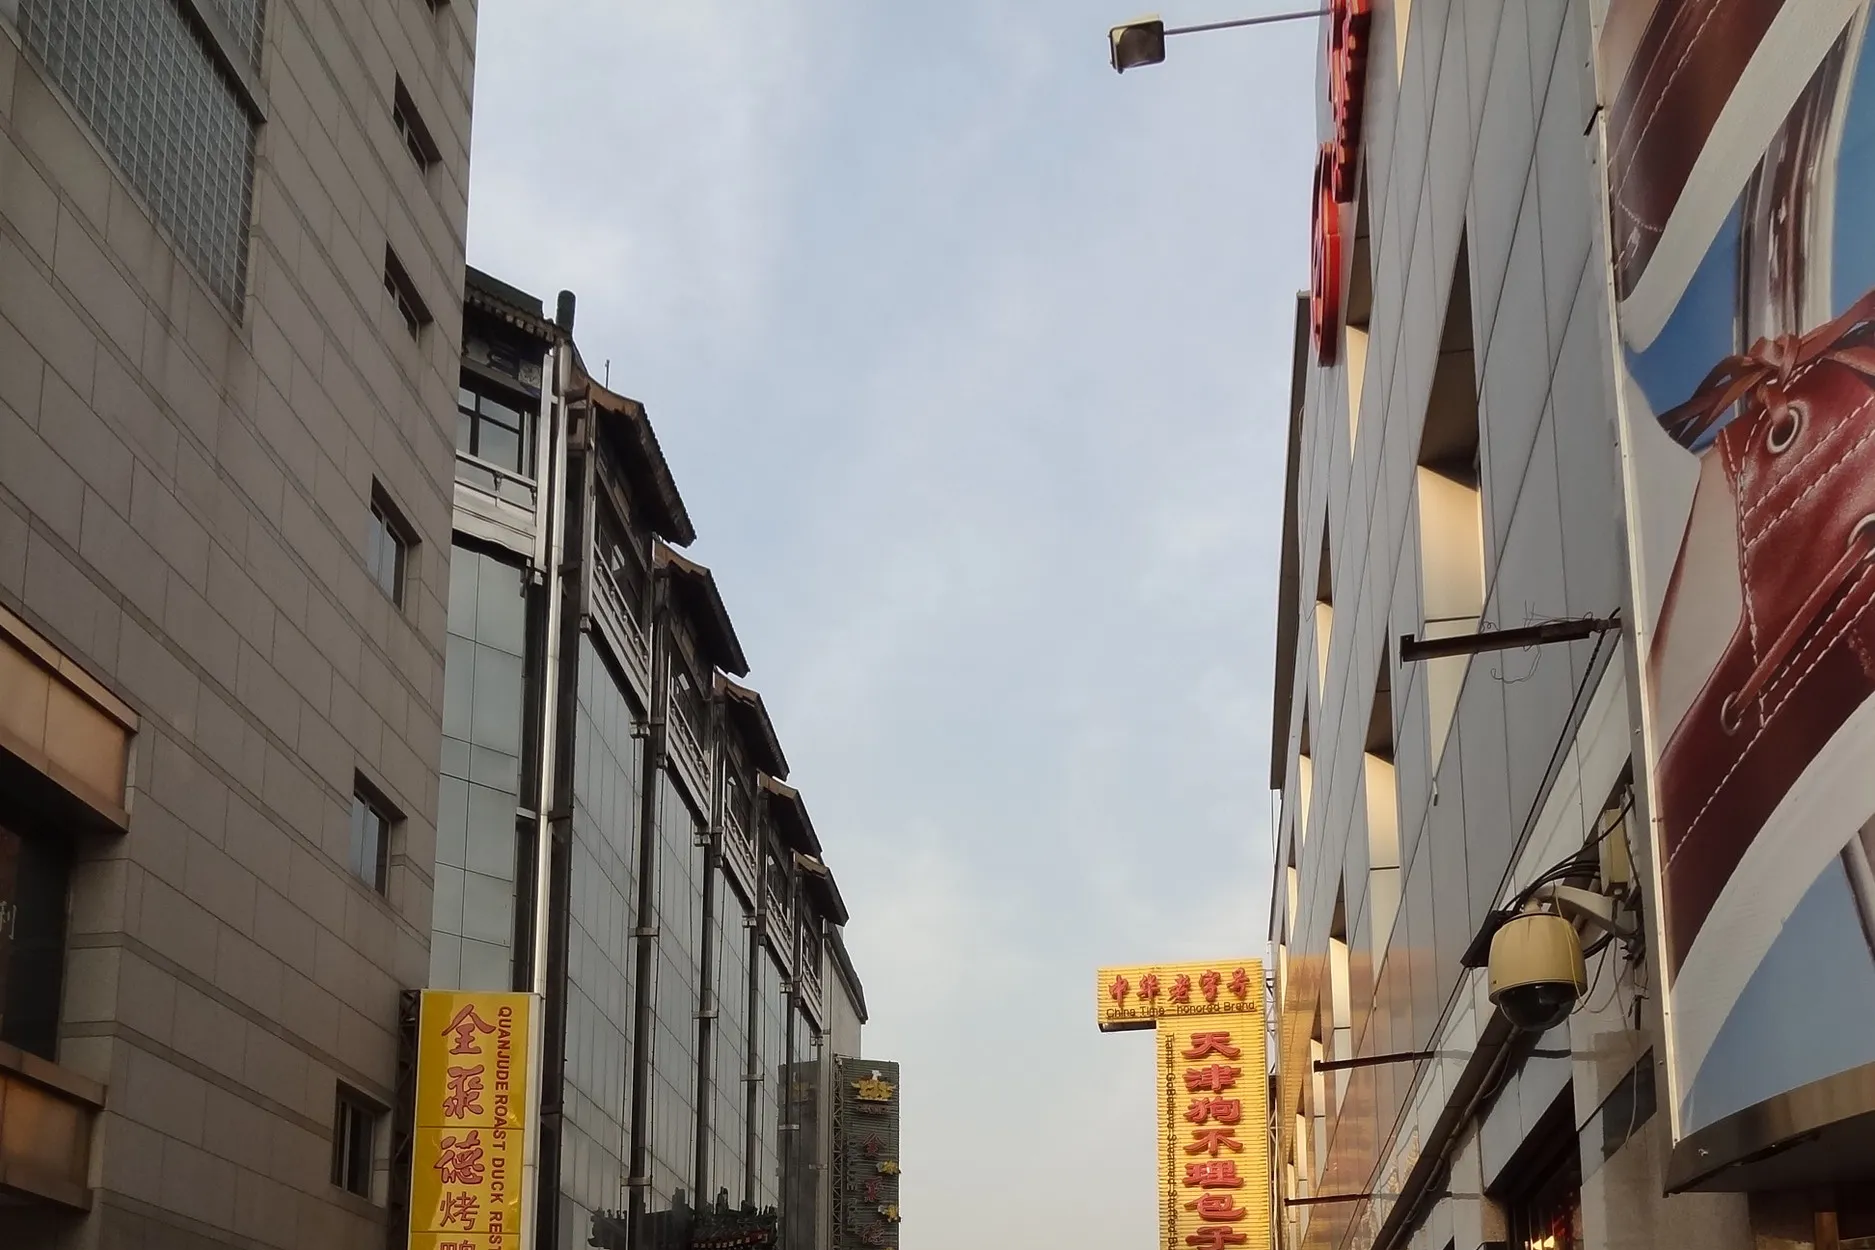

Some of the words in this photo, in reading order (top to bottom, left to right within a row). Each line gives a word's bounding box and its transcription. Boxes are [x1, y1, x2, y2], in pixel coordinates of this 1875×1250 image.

[1106, 1008, 1136, 1019] China
[1223, 1000, 1255, 1012] Brand
[1108, 966, 1251, 1008] 中华老字号
[495, 1006, 513, 1091] QUANJUDE
[493, 1094, 508, 1151] ROAST
[491, 1157, 506, 1204] DUCK
